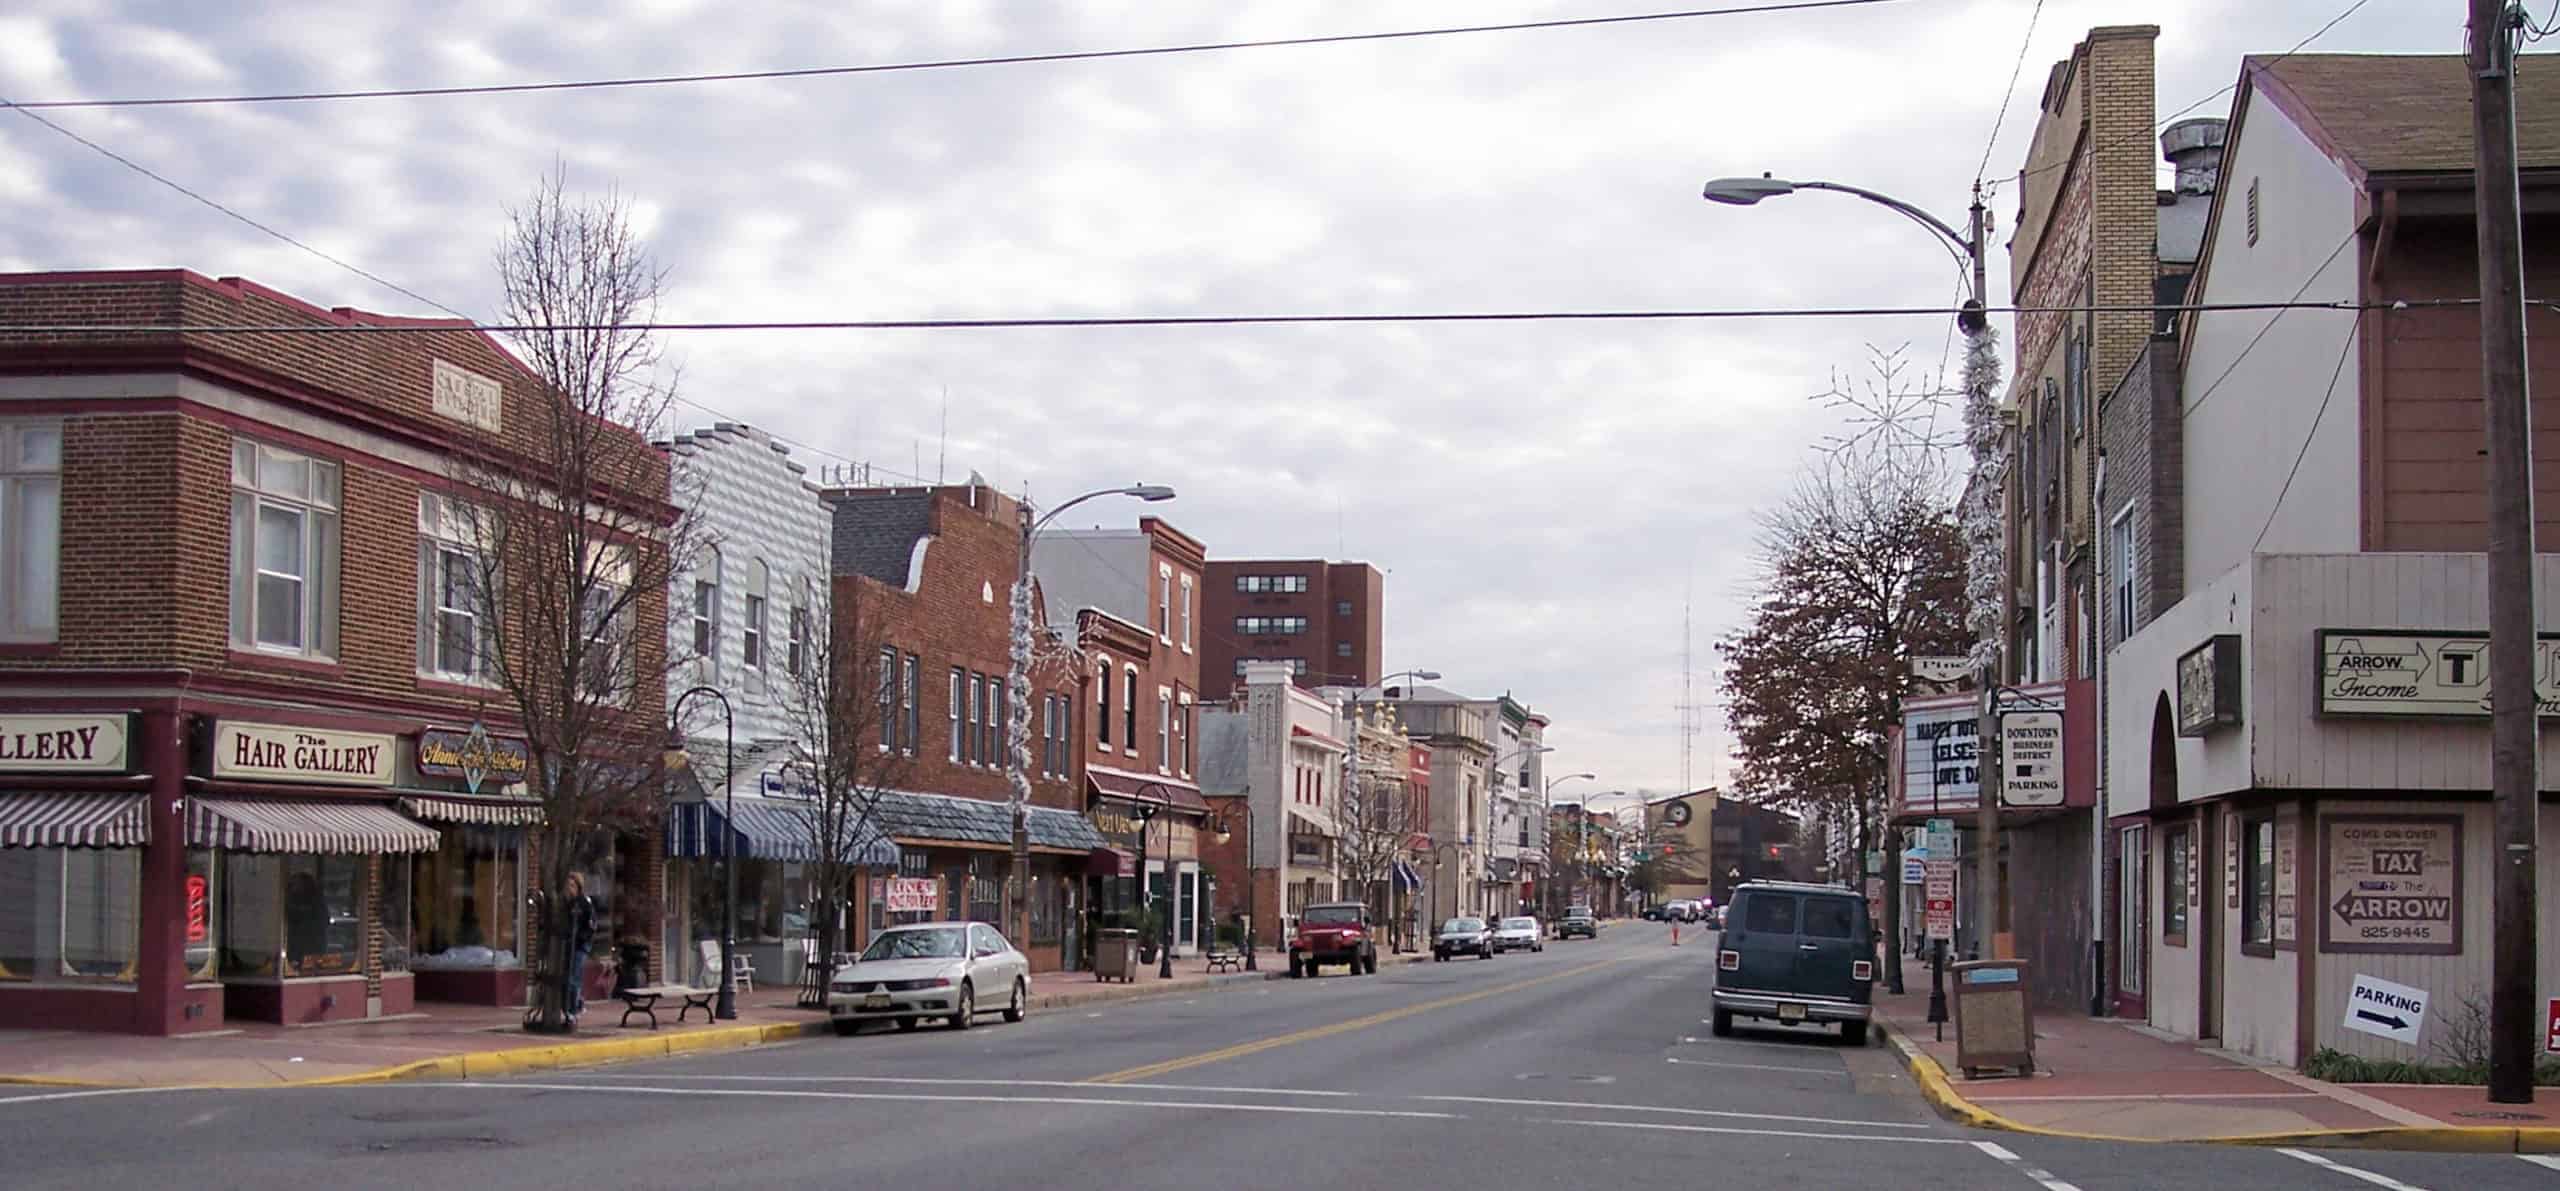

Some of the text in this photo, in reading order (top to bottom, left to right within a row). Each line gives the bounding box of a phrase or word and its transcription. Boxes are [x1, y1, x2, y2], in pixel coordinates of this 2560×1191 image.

[2339, 655, 2403, 669] ARROW
[2331, 677, 2419, 698] Income
[1916, 721, 1951, 740] HAPPY
[2007, 727, 2059, 738] DOWNTOWN
[295, 734, 327, 746] The
[2012, 741, 2054, 750] BUSINESS
[234, 732, 381, 775] HAIR GALLERY
[2013, 751, 2052, 760] DISTRICT
[2008, 780, 2058, 790] PARKING
[2343, 829, 2438, 839] COME ON OVER
[2375, 852, 2417, 873] TAX
[2403, 880, 2424, 891] The
[2349, 899, 2448, 918] ARROW
[2354, 985, 2422, 1014] PARKING
